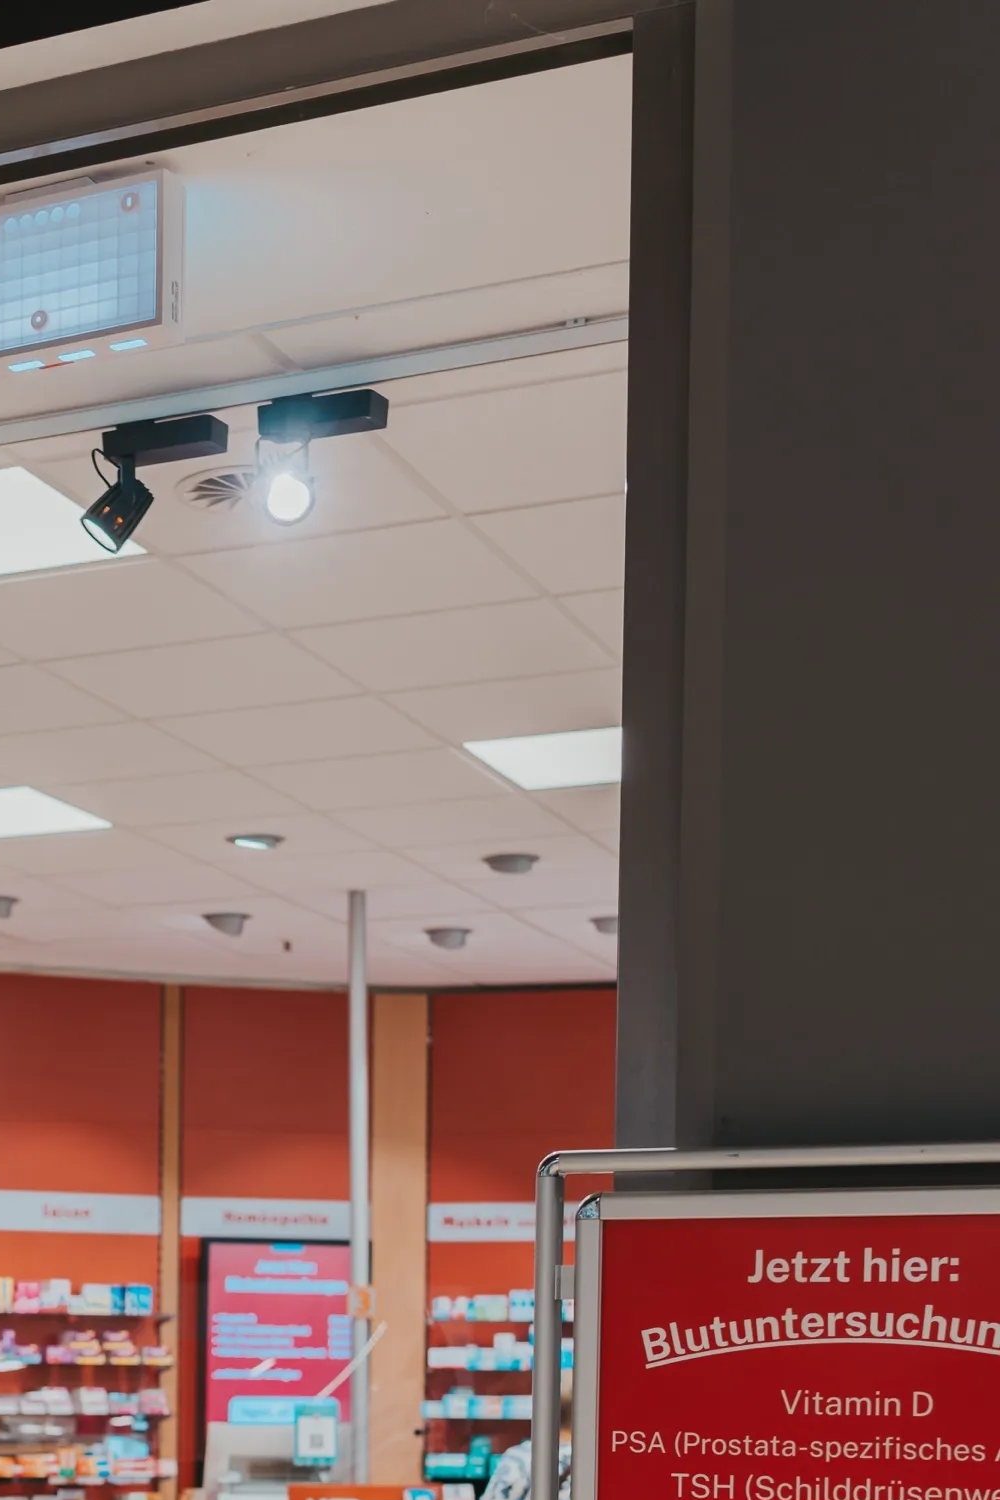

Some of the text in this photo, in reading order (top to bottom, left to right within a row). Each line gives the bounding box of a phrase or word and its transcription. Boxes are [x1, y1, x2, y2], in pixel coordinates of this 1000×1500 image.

[747, 1247, 960, 1283] Jetzt hier:
[780, 1389, 934, 1417] Vitamin D
[611, 1431, 986, 1463] PSA (Prostata-spezifisches
[671, 1473, 735, 1500] TSH
